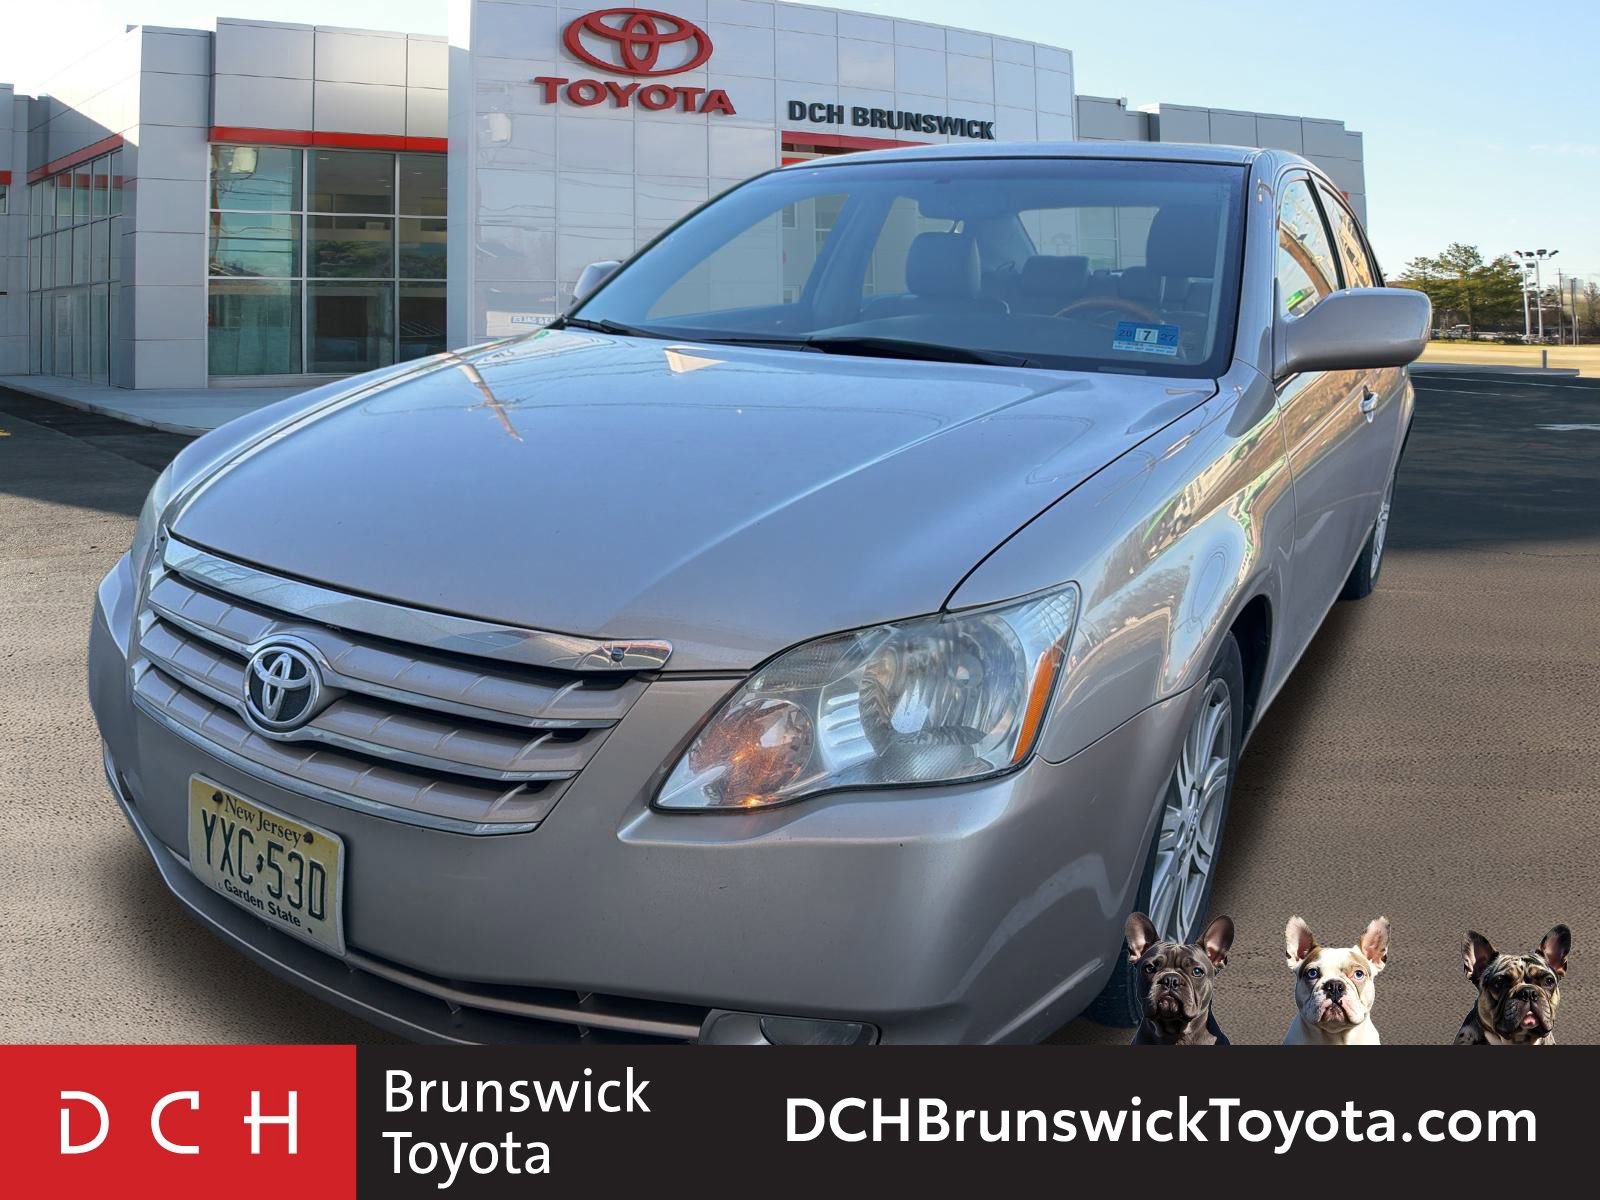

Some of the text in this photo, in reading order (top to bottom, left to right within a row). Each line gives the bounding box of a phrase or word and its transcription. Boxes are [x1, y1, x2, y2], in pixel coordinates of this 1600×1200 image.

[534, 76, 736, 115] TOYOTA
[788, 100, 995, 140] DCH BRUNSWICK
[1143, 330, 1152, 341] 7
[225, 794, 302, 848] New Jersey
[224, 879, 301, 927] Garden State
